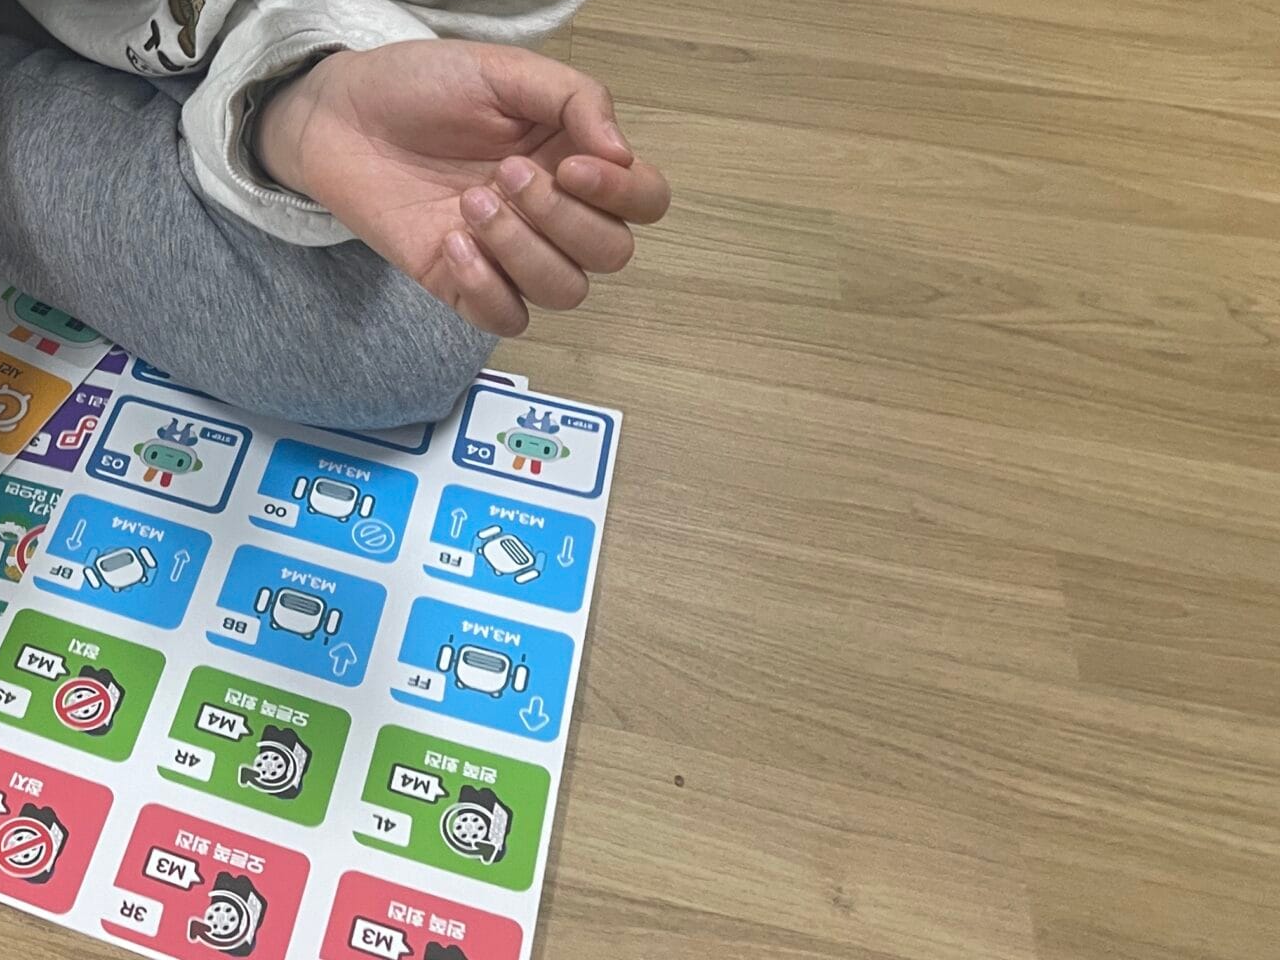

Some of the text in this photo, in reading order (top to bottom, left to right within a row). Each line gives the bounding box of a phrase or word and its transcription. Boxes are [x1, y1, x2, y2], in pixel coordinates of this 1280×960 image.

[573, 420, 593, 430] STEP
[212, 432, 232, 443] STEP
[488, 505, 544, 529] M3,M4
[112, 516, 164, 542] M3,M4
[439, 552, 462, 567] FB
[50, 565, 74, 580] BF
[280, 567, 336, 594] M3,M4
[223, 617, 248, 634] BB
[461, 620, 521, 647] M3,M4
[27, 652, 56, 672] M4
[407, 674, 432, 690] FF
[224, 688, 309, 726] 오른쪽 회전
[208, 711, 237, 733] M4
[174, 748, 201, 767] 4R
[424, 750, 498, 786] 왼쪽 회전
[401, 773, 431, 795] M4
[372, 813, 397, 833] 4L
[174, 829, 266, 874] 오른쪽 회전
[156, 857, 187, 881] M3
[120, 901, 148, 923] 3R
[387, 900, 467, 940] 왼쪽 회전
[362, 927, 394, 951] M3
